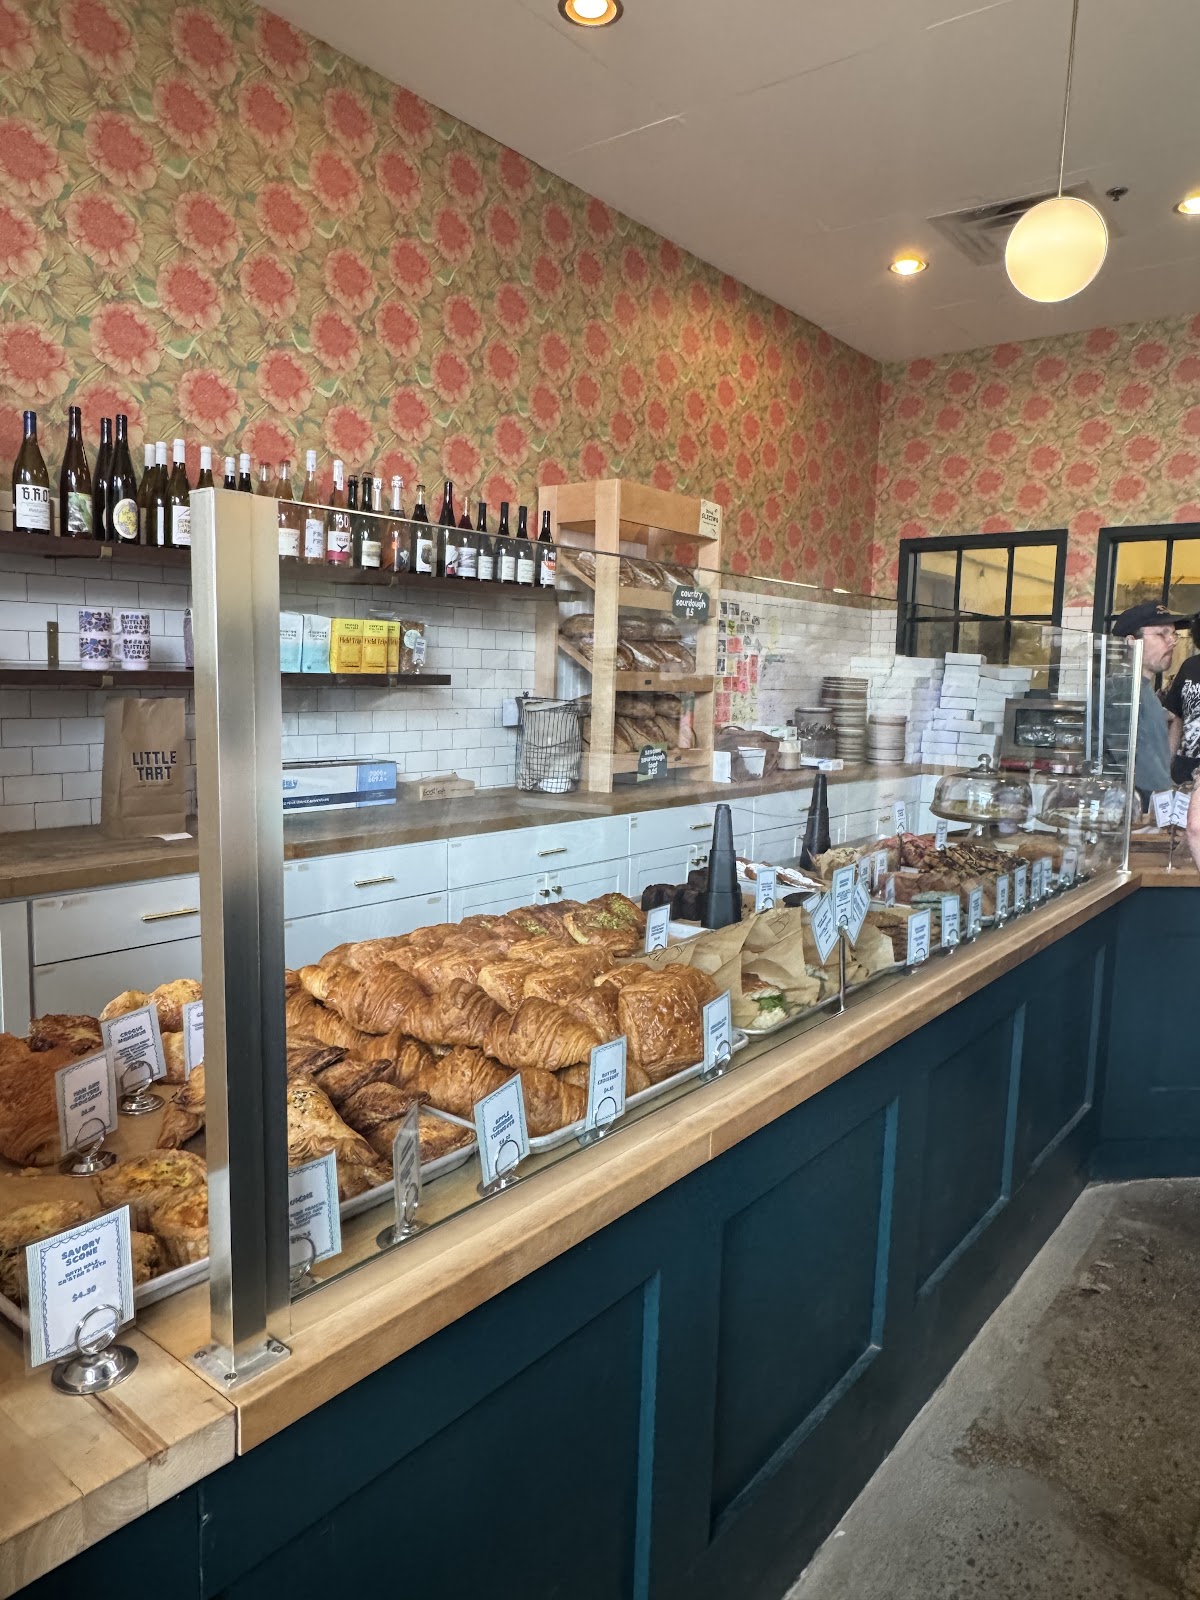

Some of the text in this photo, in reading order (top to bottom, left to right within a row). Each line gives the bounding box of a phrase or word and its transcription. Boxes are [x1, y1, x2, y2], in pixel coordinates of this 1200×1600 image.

[680, 590, 703, 601] country
[675, 598, 706, 611] sourdough
[133, 750, 177, 765] LITTLE
[137, 766, 172, 781] TART
[120, 1025, 143, 1038] CROQUE
[70, 1090, 102, 1110] CROISSANT
[61, 1236, 101, 1260] SAVORY
[65, 1246, 98, 1266] SCONE
[65, 1267, 82, 1278] WITH
